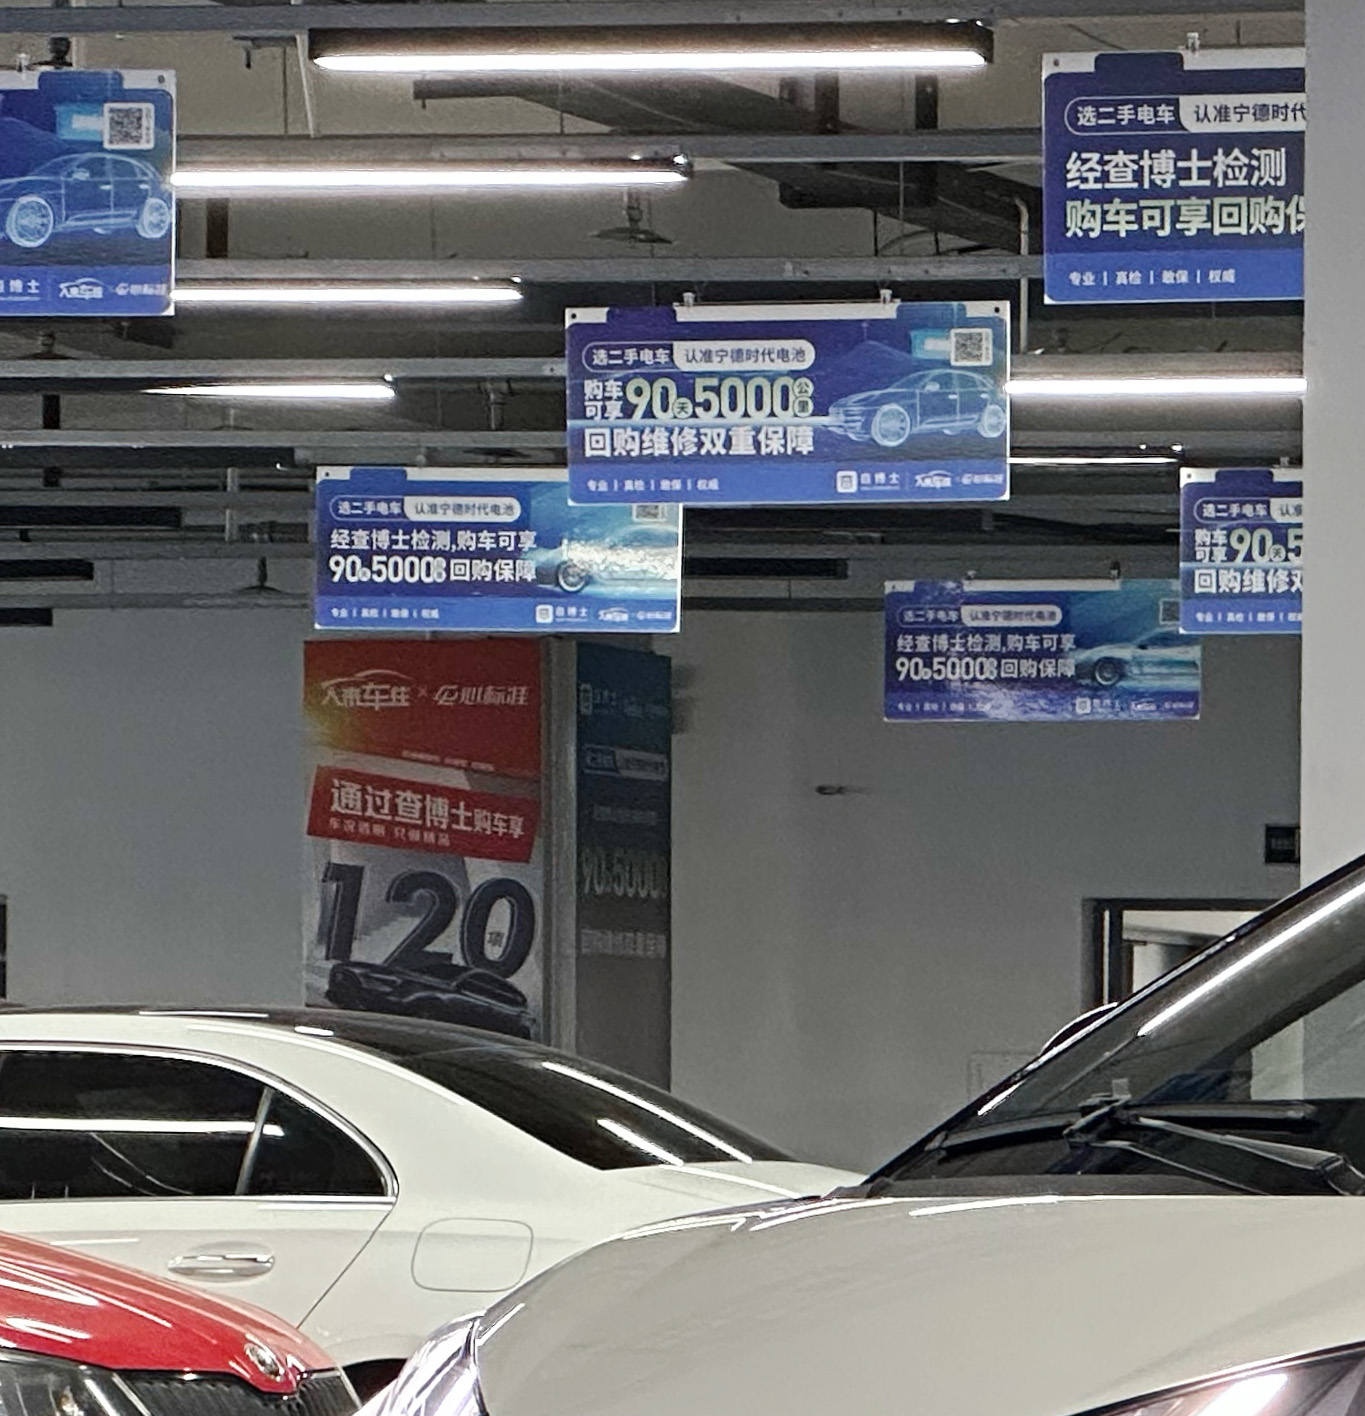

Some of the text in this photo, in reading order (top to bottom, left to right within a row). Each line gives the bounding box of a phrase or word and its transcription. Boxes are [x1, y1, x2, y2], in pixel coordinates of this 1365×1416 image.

[1077, 104, 1175, 126] 选二手电车
[1066, 147, 1286, 190] 经查博士检测
[592, 347, 807, 366] 选二手电车 认准宁德时代电池
[584, 427, 814, 457] 回购维修双重保障
[338, 501, 402, 515] 选二手电车
[1202, 503, 1268, 517] 选二手电车
[331, 529, 537, 552] 经查博士检测,购车可享
[897, 633, 1076, 653] 经查博士检测,购车可享
[330, 779, 525, 839] 通过查博士购车享
[318, 861, 536, 980] 120
